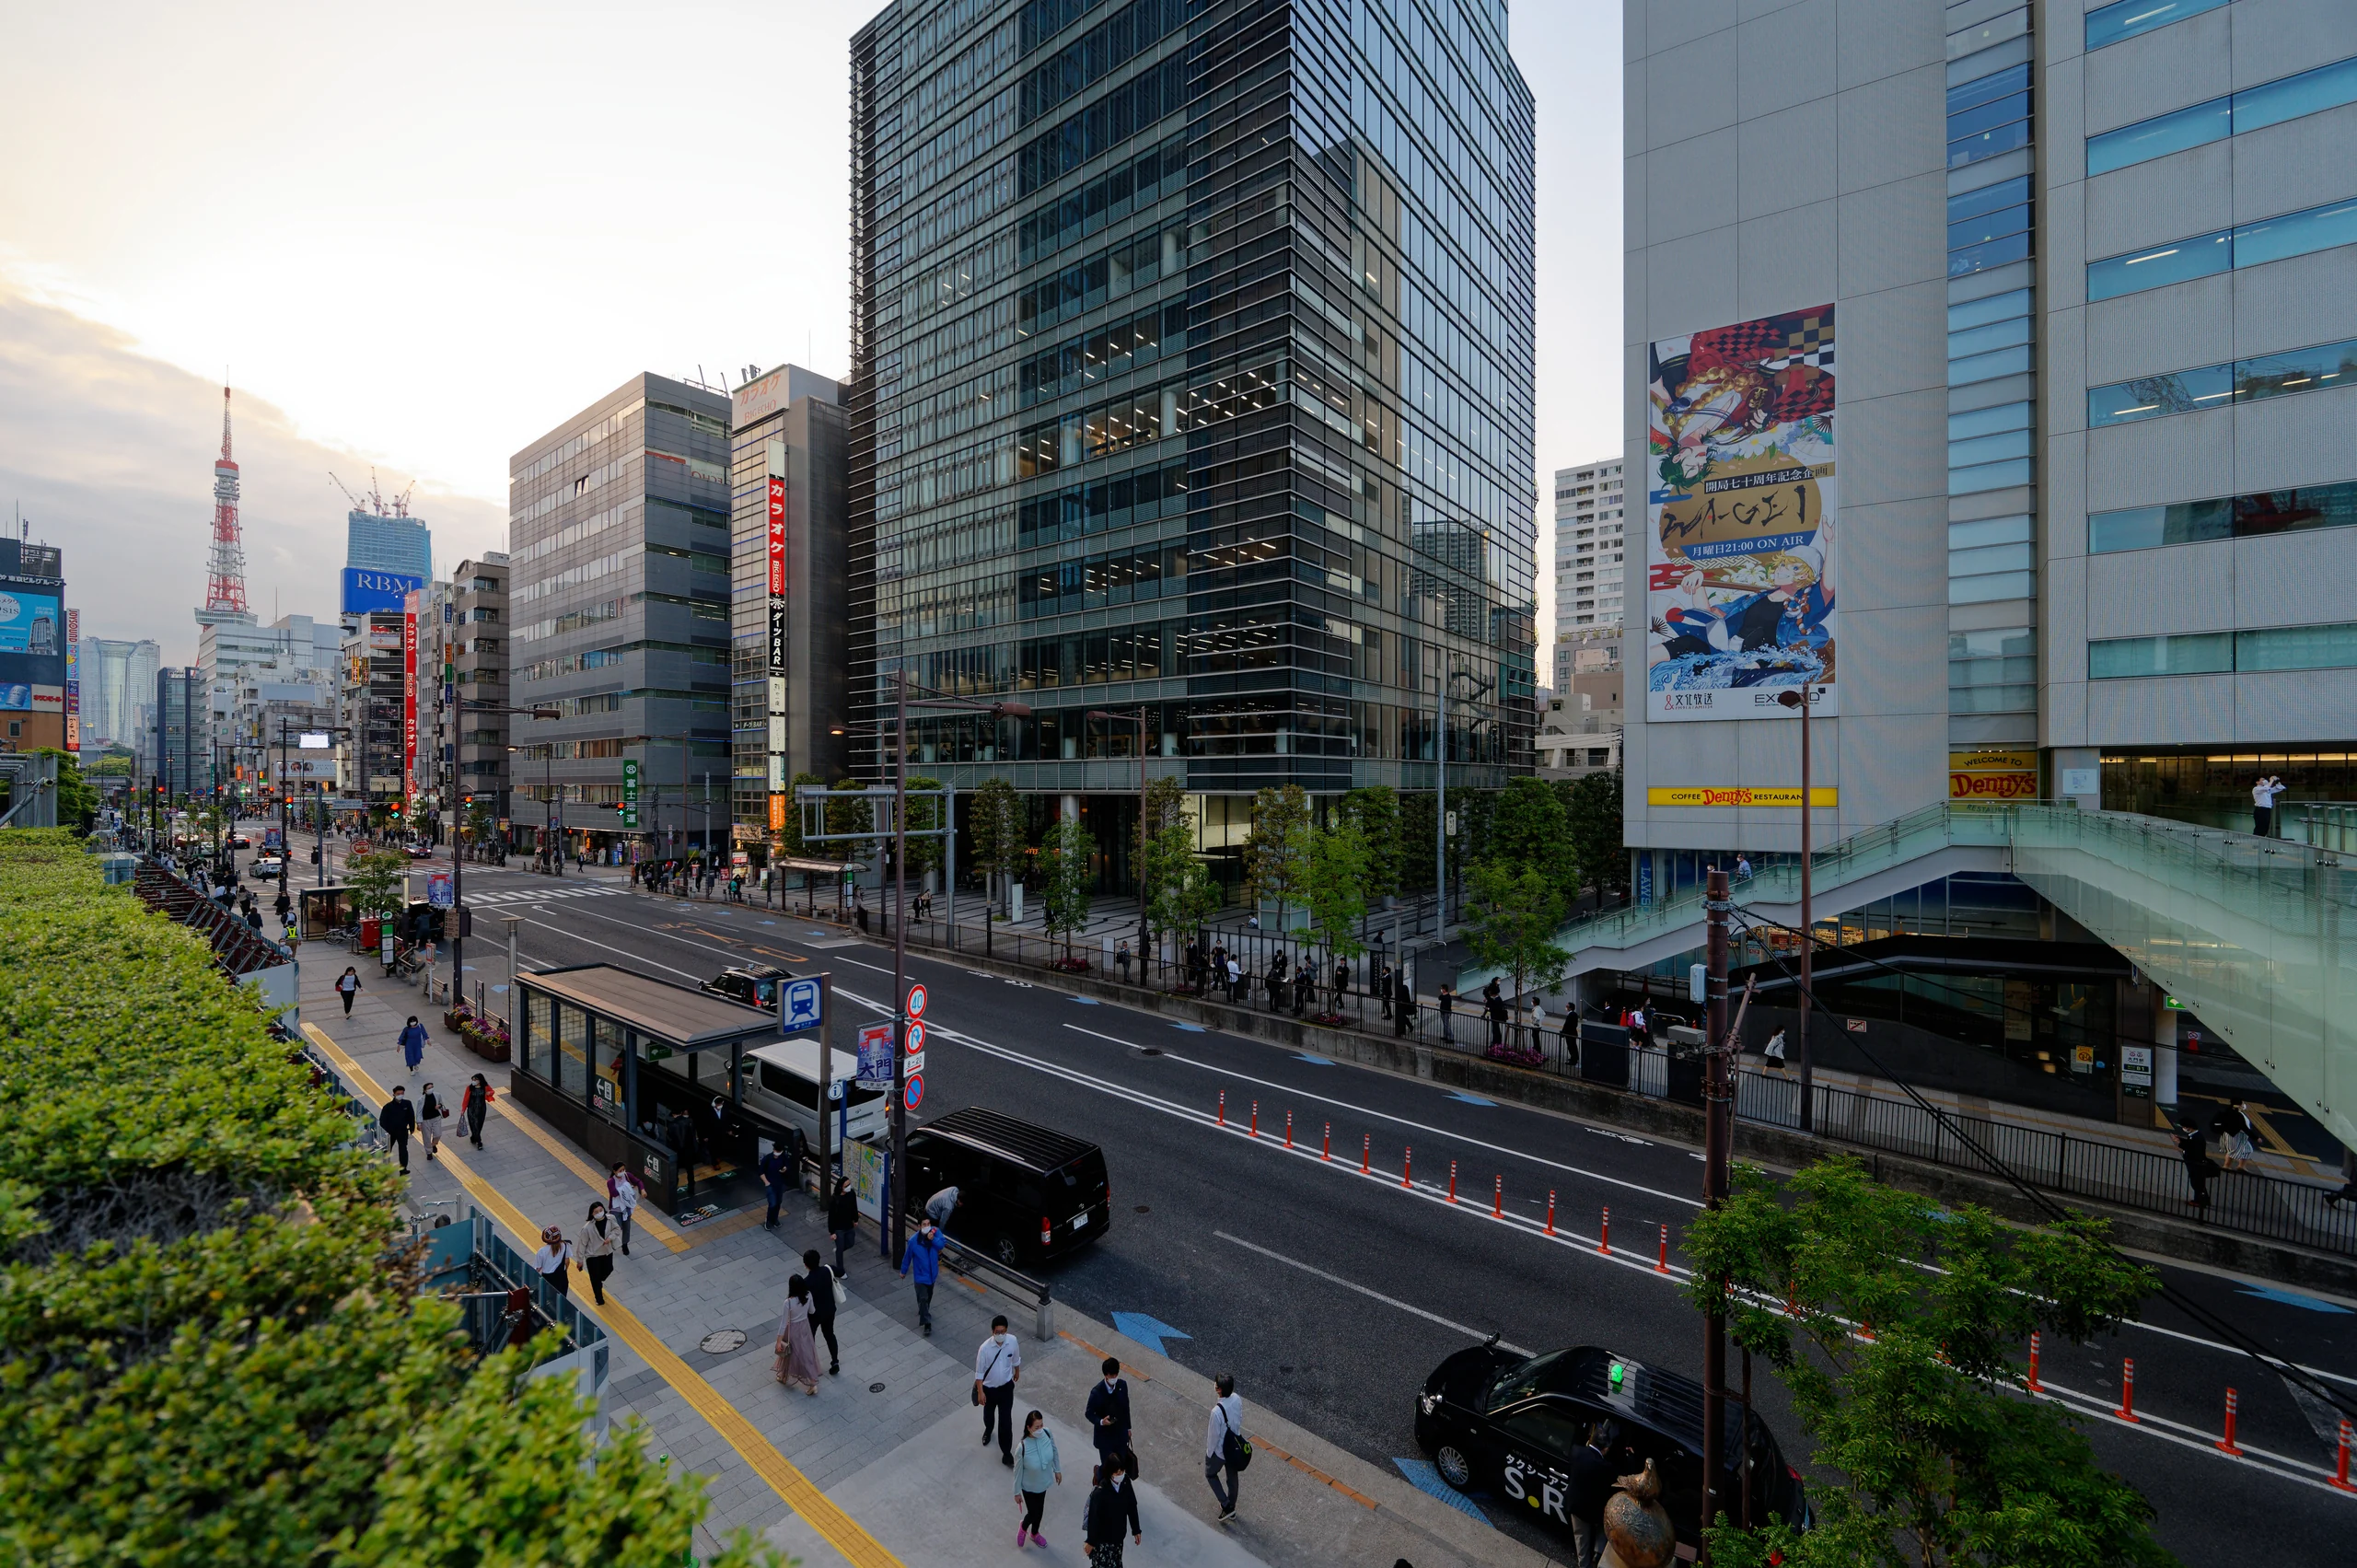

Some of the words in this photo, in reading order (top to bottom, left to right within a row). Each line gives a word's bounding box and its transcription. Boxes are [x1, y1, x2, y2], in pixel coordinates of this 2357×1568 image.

[740, 373, 782, 406] カラオケ
[1705, 465, 1828, 494] 開局七十周年記念企画
[771, 483, 784, 553] カラオケ
[1692, 541, 1754, 557] 月曜日21:00
[1757, 538, 1778, 550] ON
[1782, 535, 1805, 546] AIR
[356, 573, 413, 594] RBM
[69, 610, 77, 643] JOYSOUND
[407, 621, 415, 652] カラオケ
[1676, 693, 1713, 705] 文化放送
[407, 718, 415, 748] カラオケ
[1964, 756, 2008, 767] WELCOME
[2010, 758, 2023, 766] TO
[1702, 788, 1752, 805] Denny's
[1950, 772, 2038, 798] Denny's
[626, 779, 636, 823] 富士港運
[429, 891, 452, 902] 大門
[911, 994, 923, 1009] 40
[857, 1058, 893, 1078] 大門
